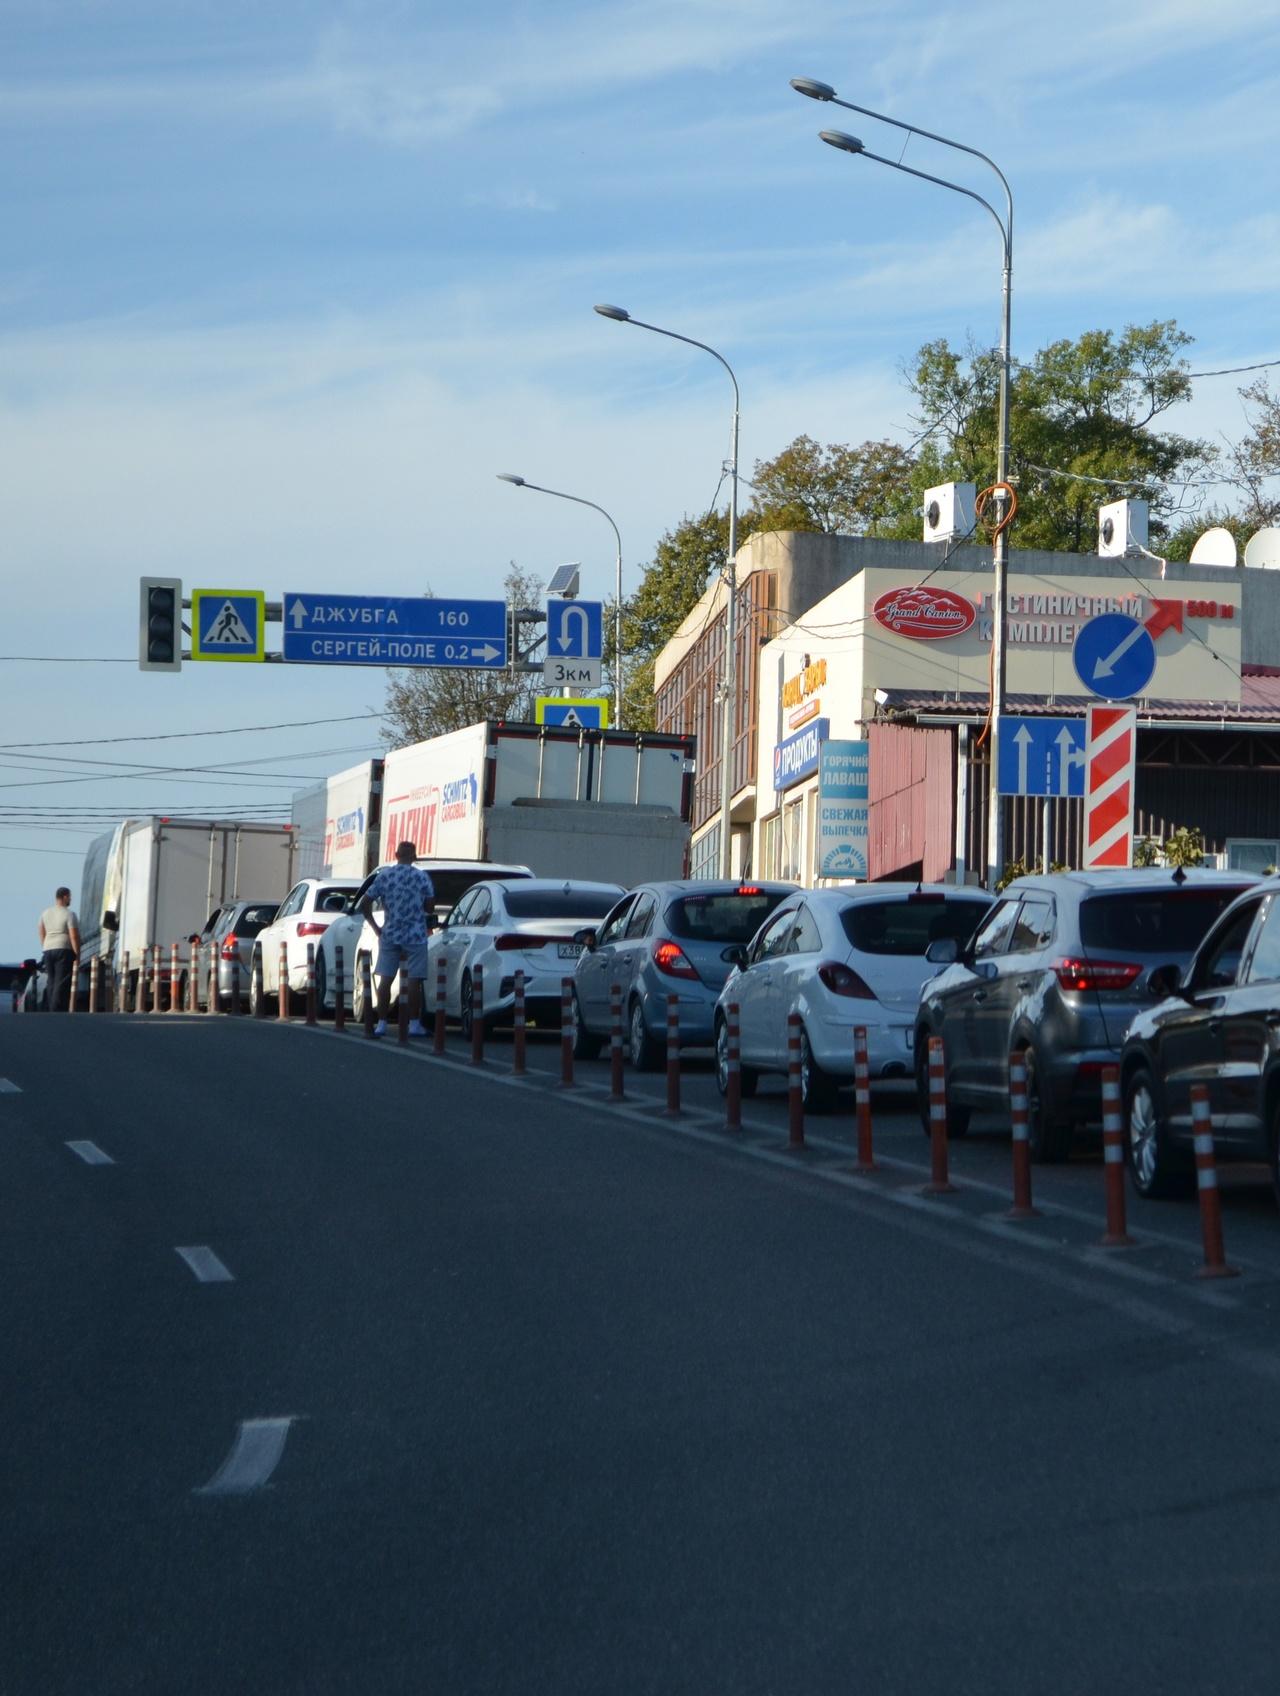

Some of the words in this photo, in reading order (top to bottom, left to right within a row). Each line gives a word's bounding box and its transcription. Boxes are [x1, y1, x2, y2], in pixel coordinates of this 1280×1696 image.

[311, 607, 399, 625] ДЖУБГА
[438, 611, 469, 626] 160
[886, 603, 921, 621] Grand
[1187, 600, 1217, 618] 500
[311, 638, 436, 659] СЕРГЕЙ-ПОЛЕ
[444, 645, 469, 660] 0.2
[781, 727, 818, 777] ПРОДУКТЫ
[823, 754, 868, 767] ГОРЯЧИЙ
[823, 772, 868, 785] ЛАВАШ
[822, 808, 868, 821] СВЕЖАЯ
[822, 825, 868, 836] ВЫПЕЧКА
